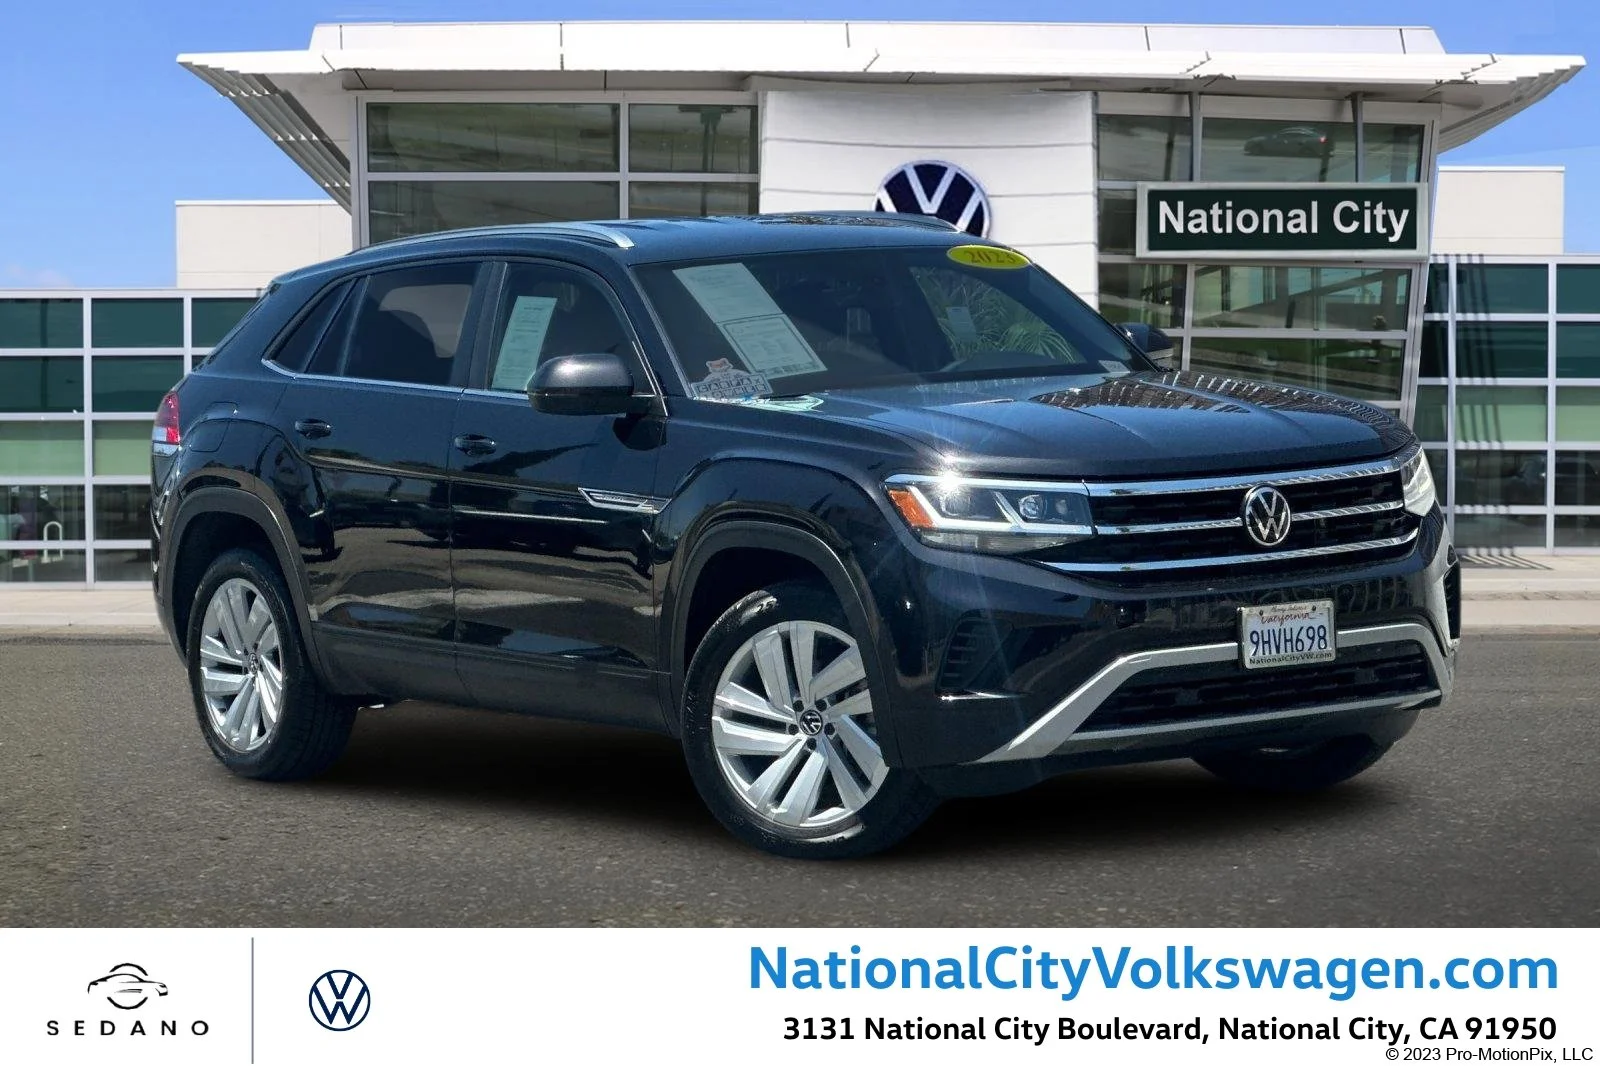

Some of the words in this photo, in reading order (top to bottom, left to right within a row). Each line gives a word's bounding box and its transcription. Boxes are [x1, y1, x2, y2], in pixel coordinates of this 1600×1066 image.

[1158, 200, 1318, 234] National
[1332, 200, 1410, 243] City
[963, 250, 1016, 264] 2023
[1249, 624, 1328, 657] 9HVH698
[1249, 652, 1332, 665] NationalCityVW.com
